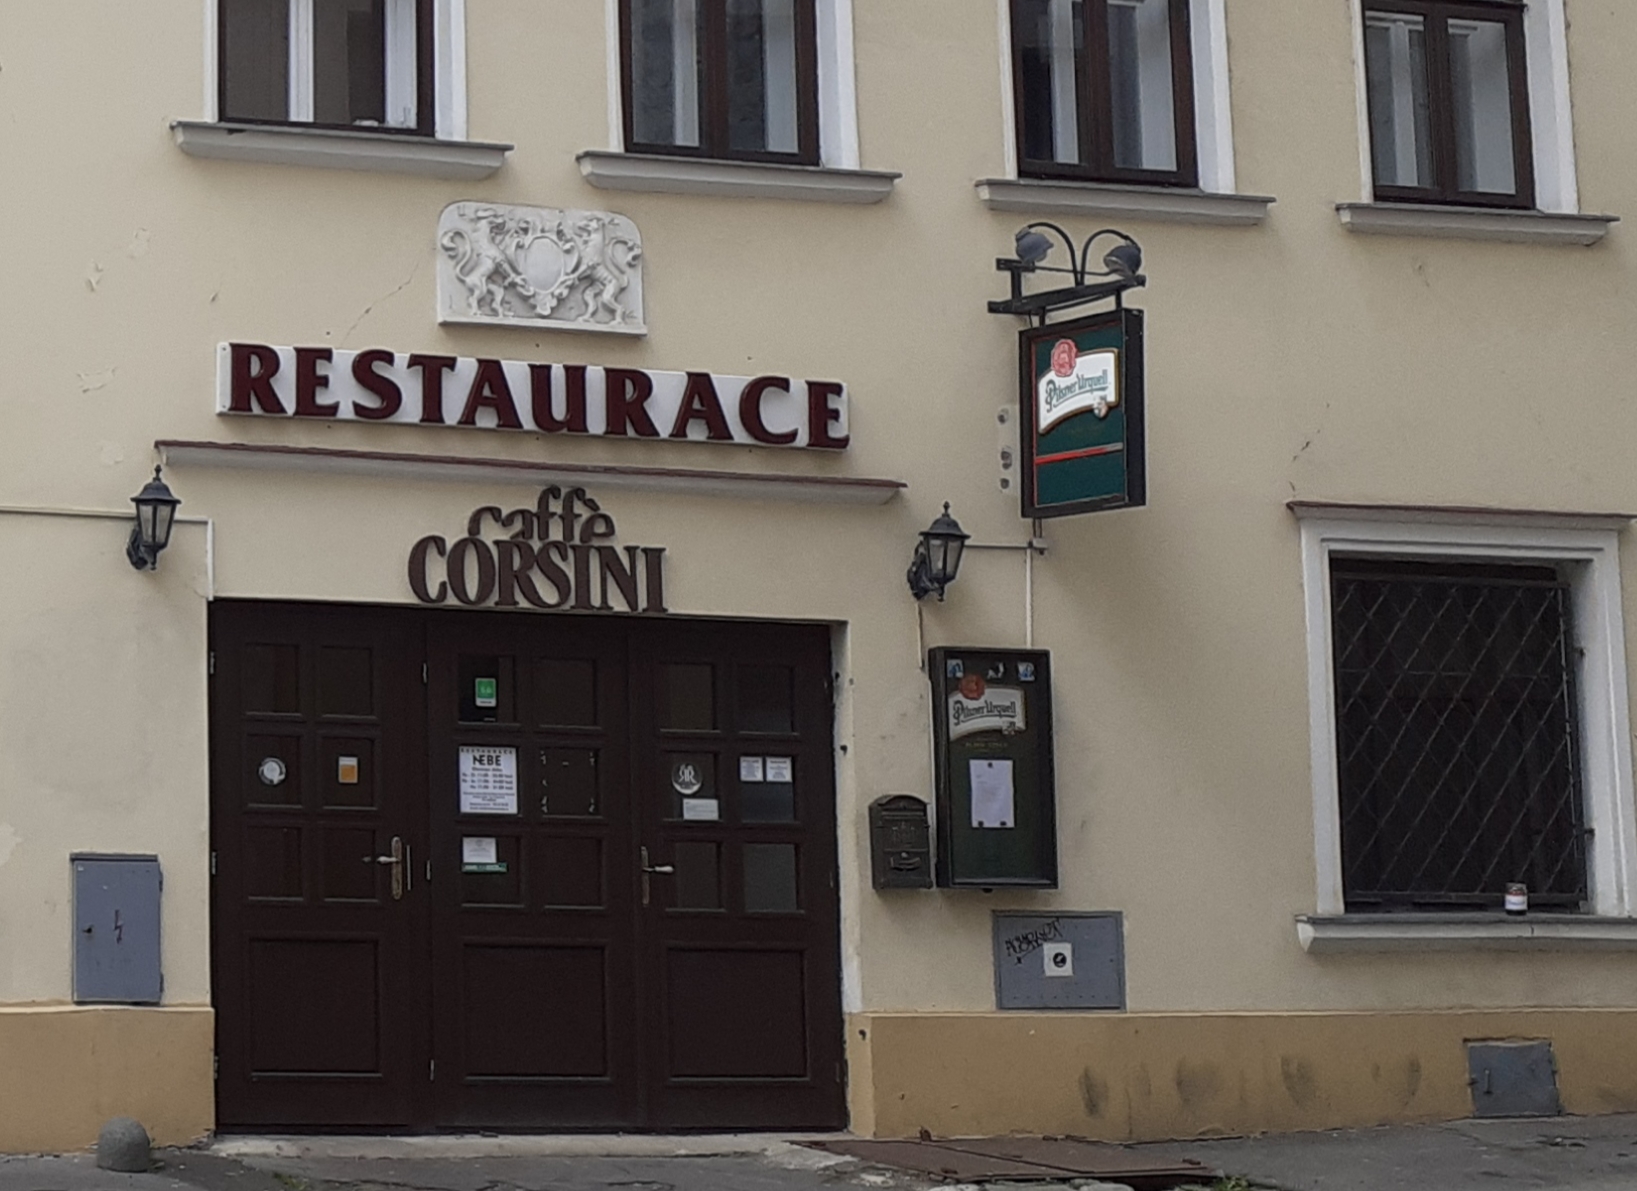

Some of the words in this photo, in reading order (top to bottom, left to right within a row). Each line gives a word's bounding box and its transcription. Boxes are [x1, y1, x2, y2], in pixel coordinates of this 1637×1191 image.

[228, 342, 851, 450] RESTAURACE
[1045, 379, 1077, 413] Pilsner
[1076, 369, 1108, 395] Urquell
[407, 535, 668, 613] CORSINI
[953, 700, 986, 726] Pilsner
[984, 700, 1016, 718] Urquell
[472, 754, 502, 767] NEBE
